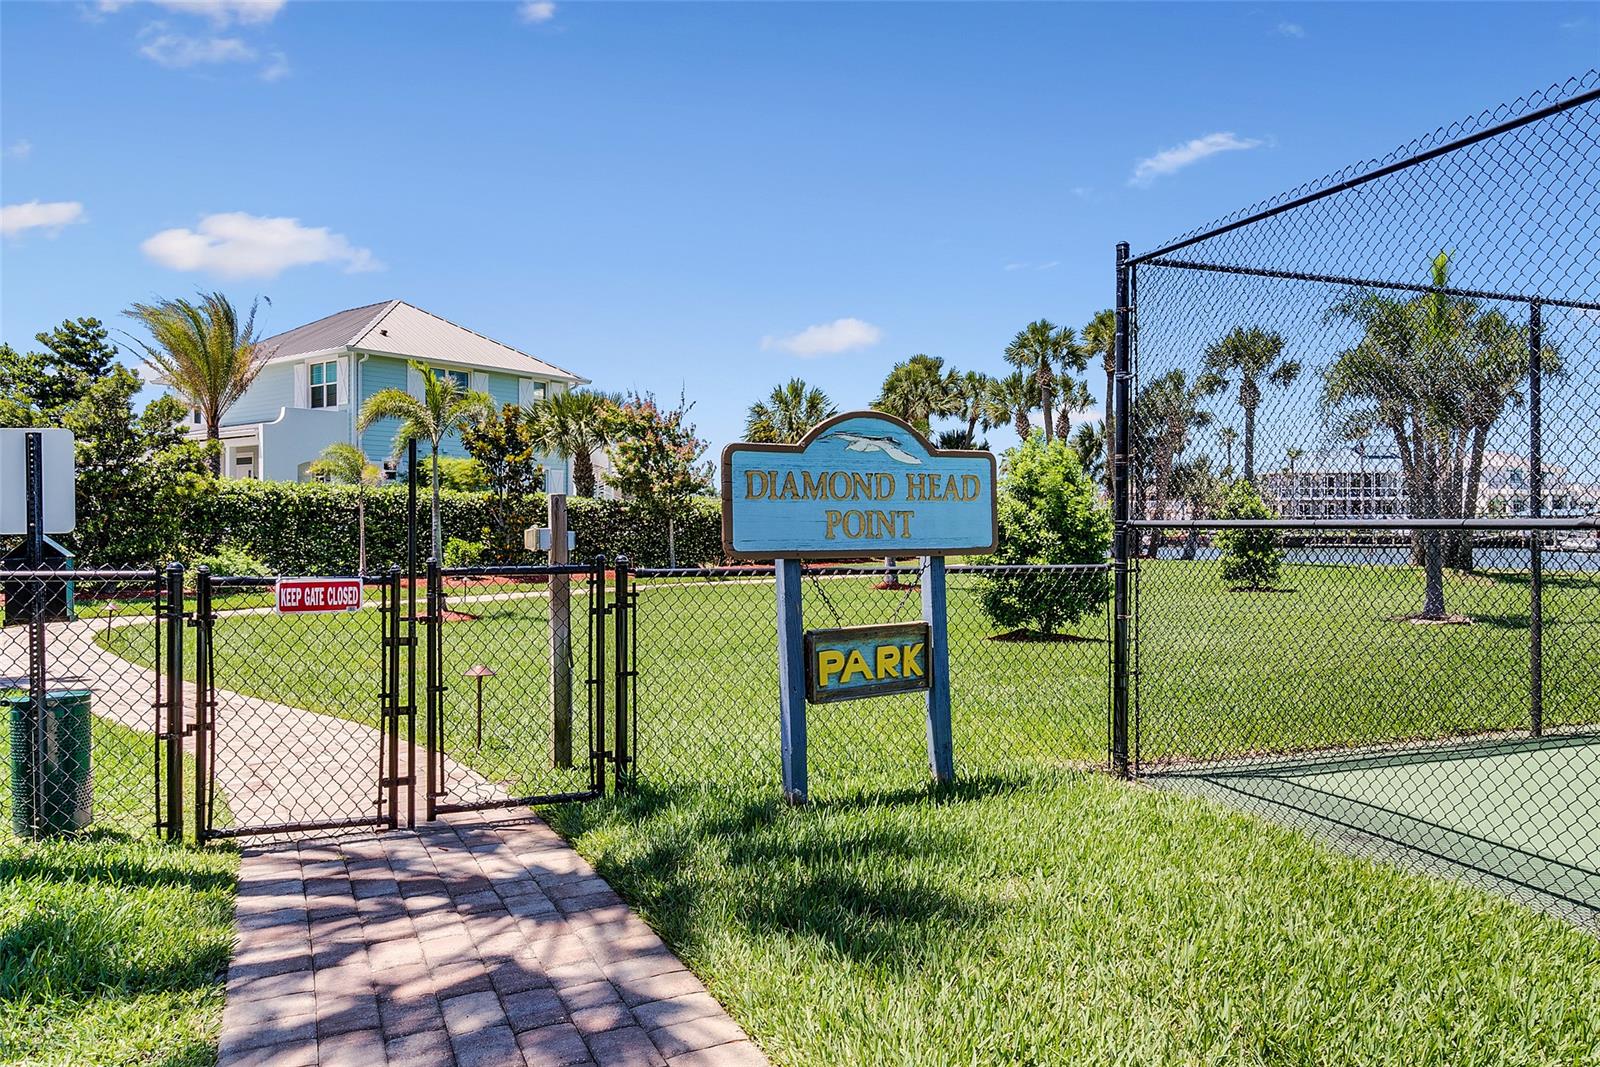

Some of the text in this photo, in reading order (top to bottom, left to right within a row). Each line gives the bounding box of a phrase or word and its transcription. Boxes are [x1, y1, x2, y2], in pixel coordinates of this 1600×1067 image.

[745, 470, 981, 502] DIAMOND HEAD
[824, 509, 915, 540] POINT
[280, 586, 359, 607] KEEP GATE CLOSED
[818, 642, 924, 687] PARK
